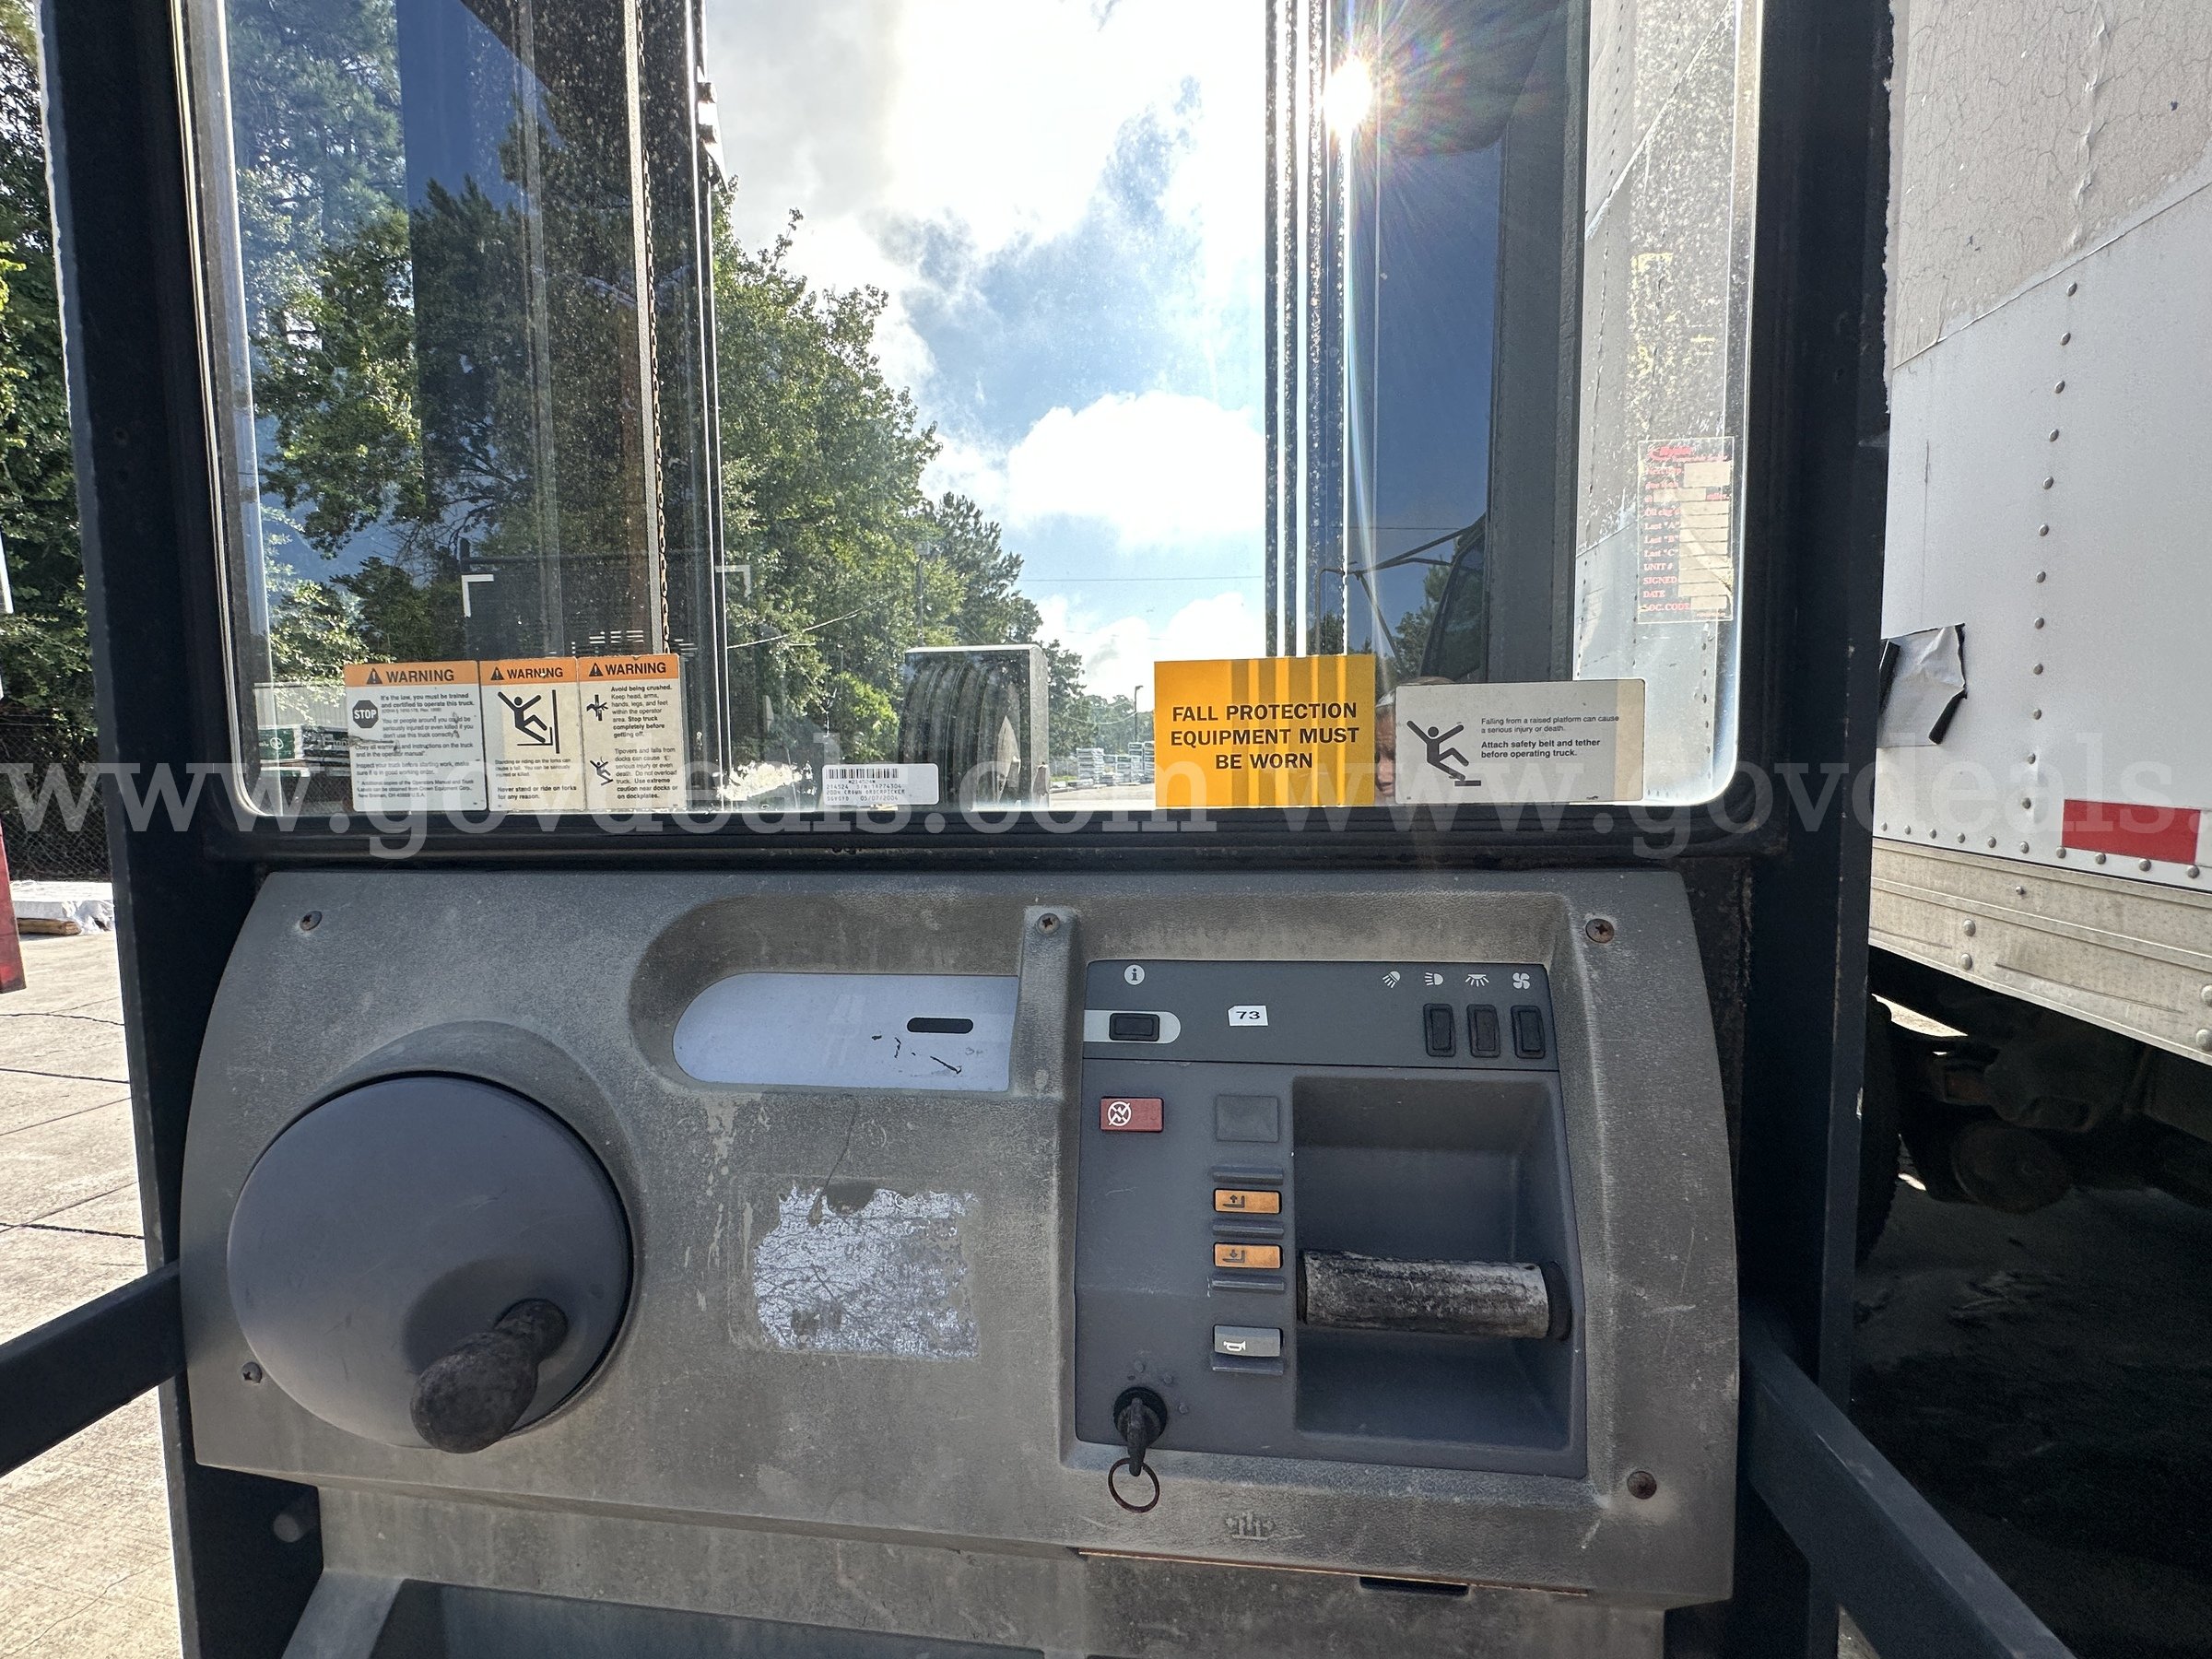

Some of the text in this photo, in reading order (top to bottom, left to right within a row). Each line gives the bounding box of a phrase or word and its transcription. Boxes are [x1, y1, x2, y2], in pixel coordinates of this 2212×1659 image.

[507, 667, 563, 679] WARNING
[606, 662, 666, 676] WARNING
[386, 669, 454, 683] WARNING
[354, 710, 377, 719] STOP
[1172, 702, 1357, 722] FALL PROTECTION
[1171, 727, 1359, 747] EQUIPMENT MUST
[1512, 740, 1536, 749] safety
[1539, 739, 1554, 747] belt
[1216, 752, 1312, 770] BE WORN
[1511, 750, 1550, 759] operating
[1236, 1011, 1260, 1019] 73
